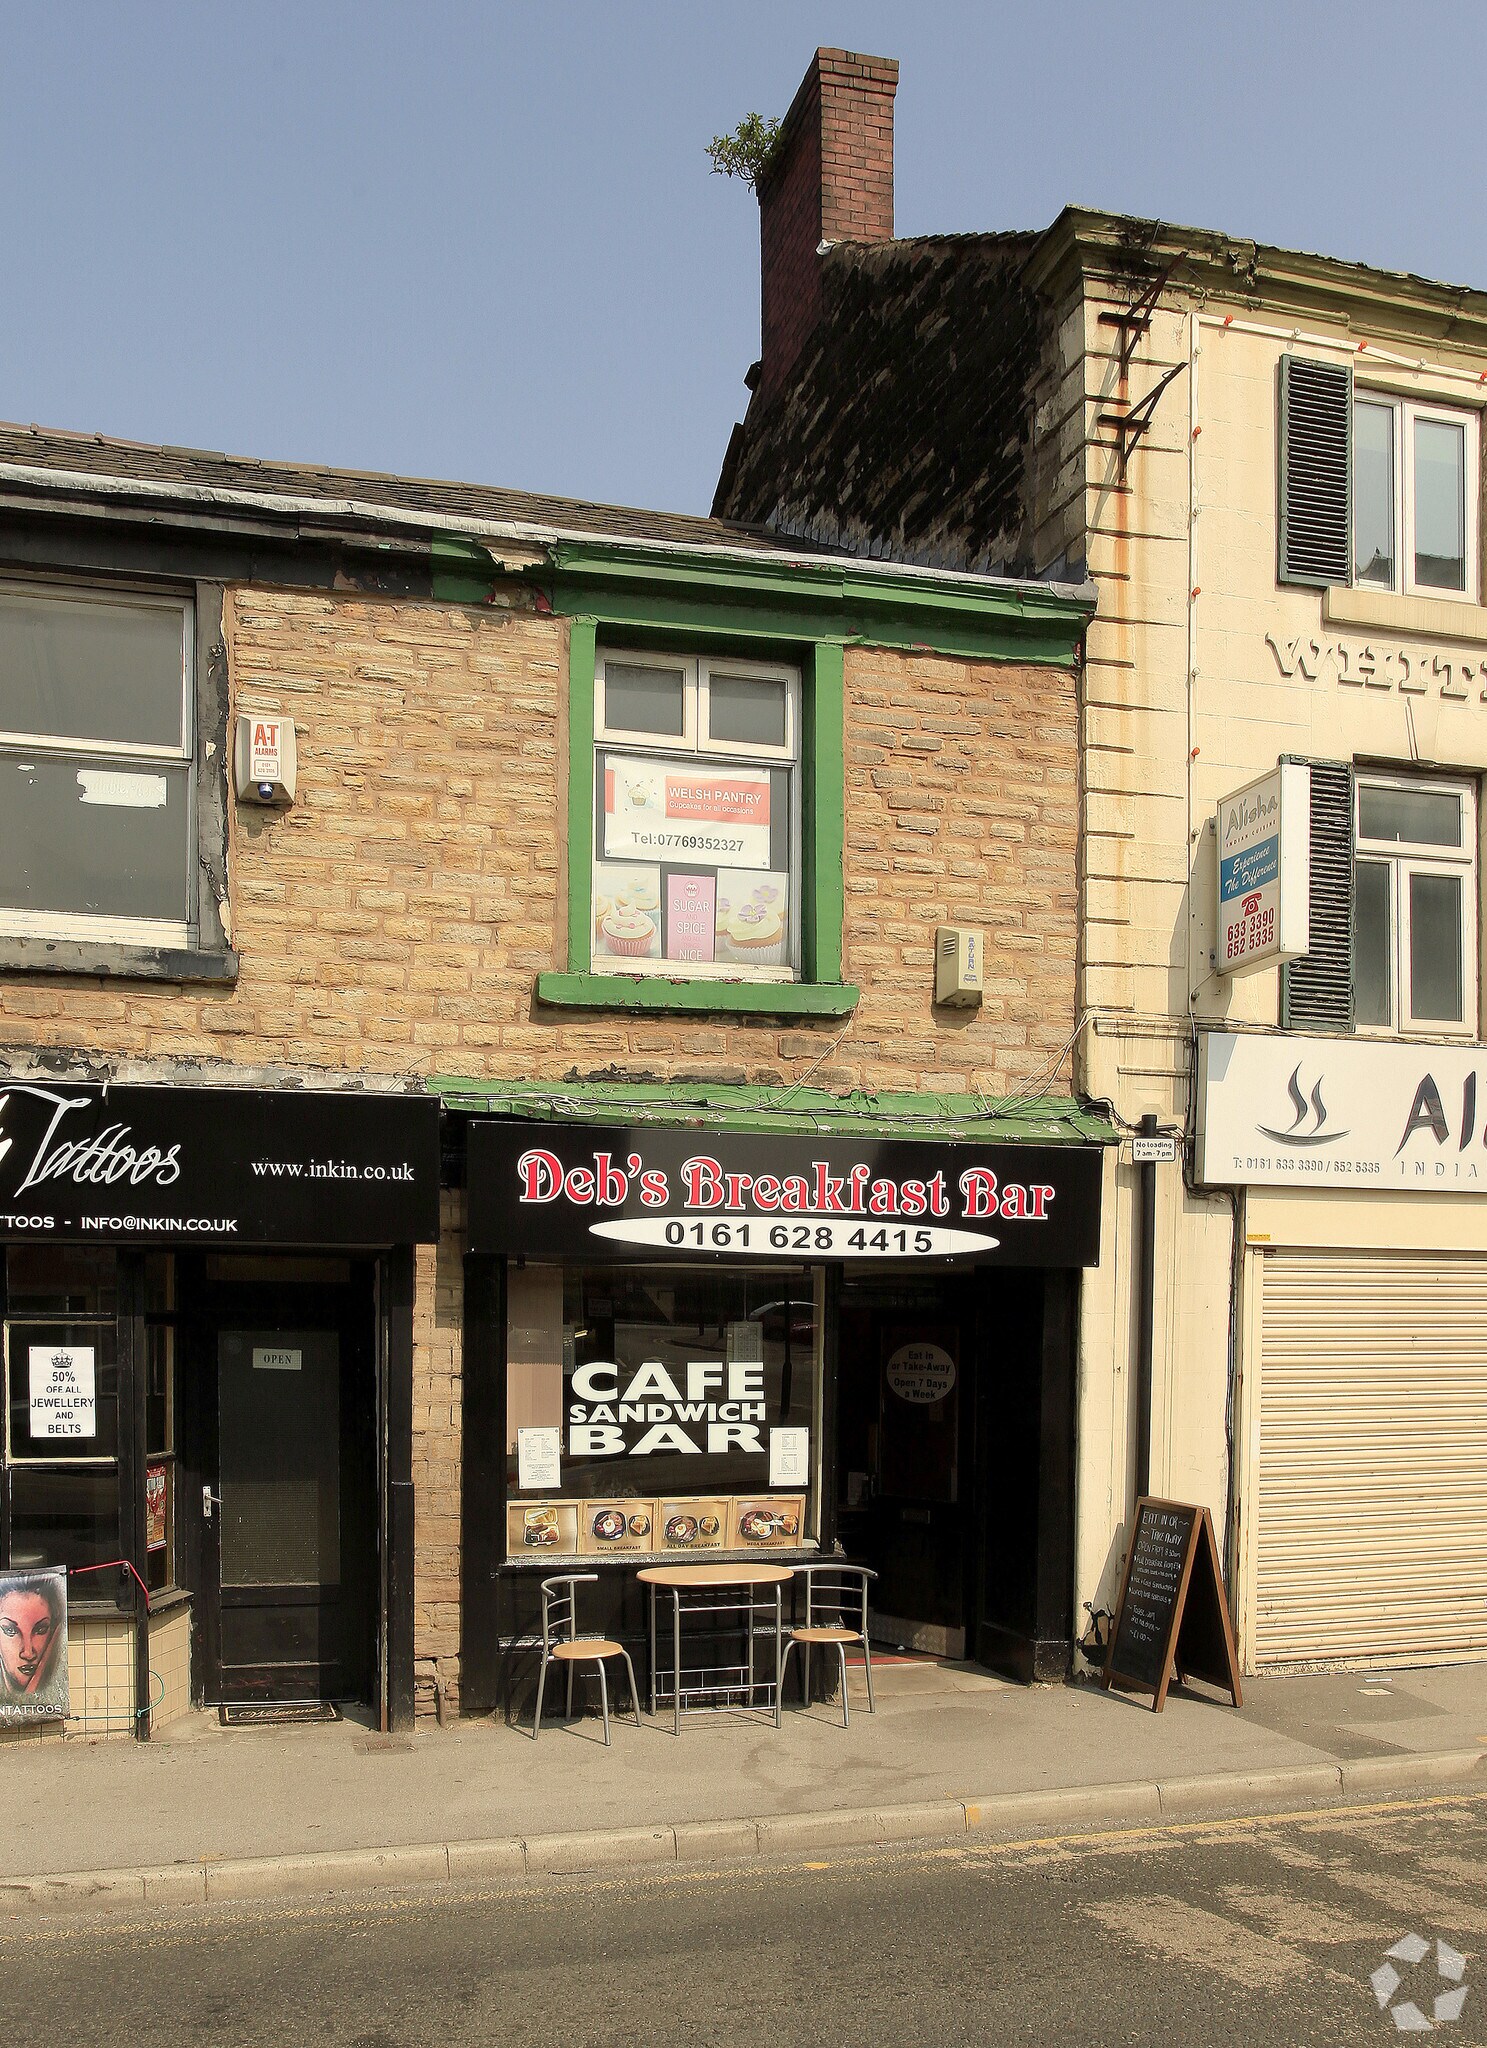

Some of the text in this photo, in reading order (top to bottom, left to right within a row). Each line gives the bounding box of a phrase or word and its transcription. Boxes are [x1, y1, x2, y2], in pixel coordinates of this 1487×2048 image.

[1265, 632, 1487, 703] WHIT
[254, 748, 278, 757] ALARMS
[669, 787, 762, 805] WELSH PANTRY
[669, 800, 702, 810] Cupcakes
[703, 803, 712, 811] for
[722, 806, 754, 815] occasions
[1225, 794, 1278, 840] Alisha
[1226, 819, 1276, 848] INDIAN CUISINE
[1232, 846, 1270, 875] Experience
[1224, 859, 1277, 895] The Difference
[673, 899, 710, 912] SUGAR
[676, 921, 706, 934] SPICE
[1227, 907, 1274, 942] 633 3390
[1227, 925, 1274, 959] 652 5335
[679, 949, 703, 961] NICE
[1392, 1070, 1487, 1160] Al
[0, 1084, 182, 1198] Tattoos
[1147, 1141, 1172, 1149] loading
[251, 1158, 415, 1182] www.inkin.co.uk
[1232, 1157, 1242, 1169] T:
[517, 1148, 1055, 1221] Deb's Breakfast Bar
[0, 1215, 55, 1229] TOOS
[81, 1216, 238, 1232] INFO@INKIN.CO.UK
[665, 1222, 933, 1253] 0161 628 4415
[263, 1354, 292, 1365] OPEN
[908, 1351, 922, 1360] Eat
[902, 1361, 951, 1374] Take-Away
[52, 1371, 76, 1382] 50%
[571, 1362, 764, 1402] CAFE
[894, 1378, 948, 1390] Open 7 Days
[46, 1385, 82, 1394] OFF ALL
[912, 1389, 936, 1399] Week
[31, 1398, 94, 1408] JEWELLERY
[55, 1411, 74, 1420] AND
[569, 1402, 766, 1423] SANDWICH
[48, 1424, 82, 1434] BELTS
[569, 1423, 766, 1456] BAR
[1142, 1511, 1178, 1529] EAT IN OR
